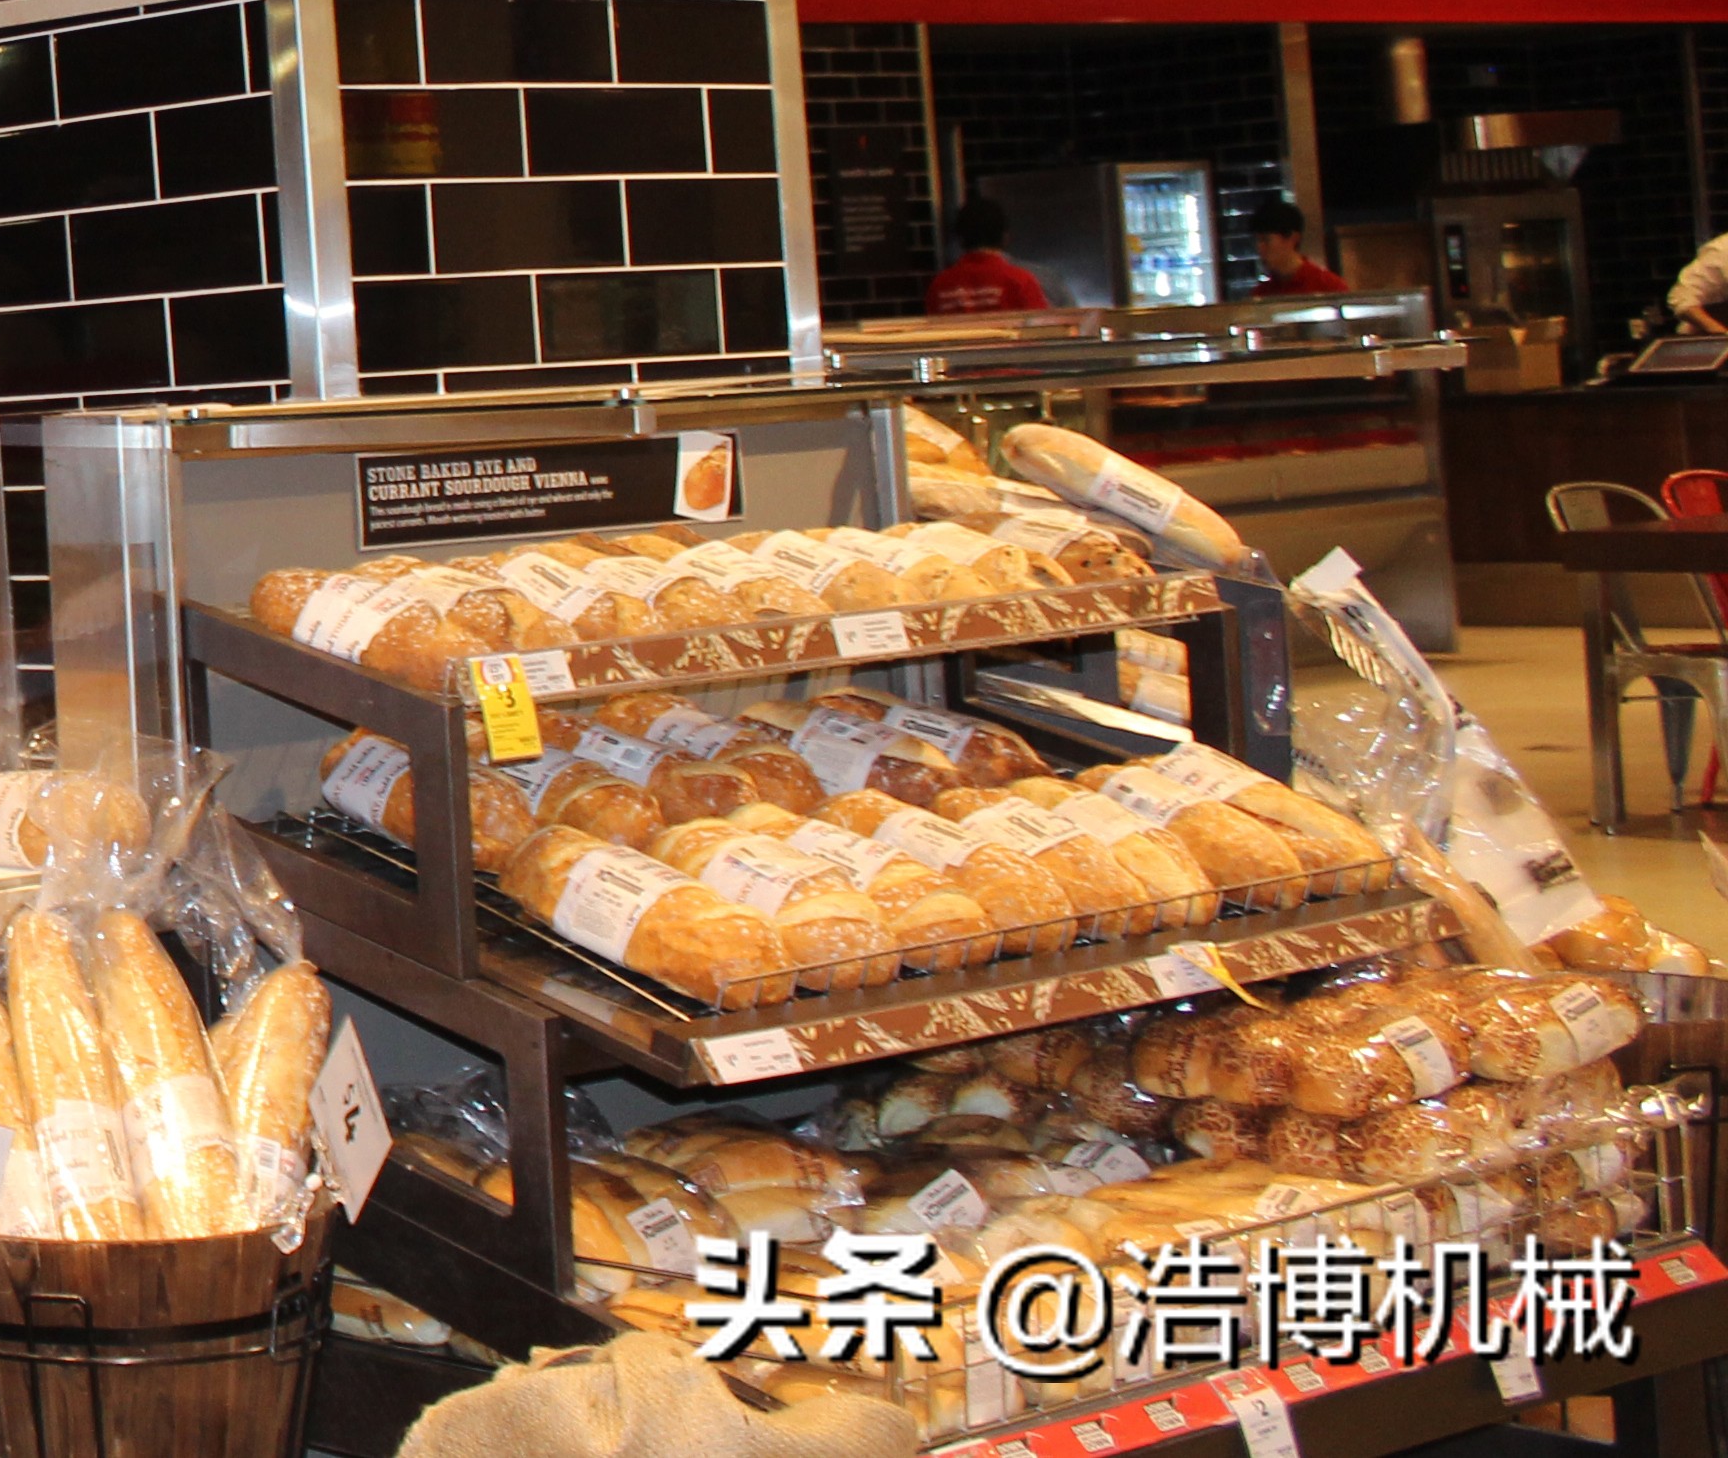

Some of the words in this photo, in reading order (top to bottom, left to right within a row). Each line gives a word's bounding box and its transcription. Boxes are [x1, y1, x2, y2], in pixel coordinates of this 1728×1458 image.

[367, 465, 416, 483] STONE
[420, 461, 471, 479] BAKED
[475, 459, 504, 476] RYE
[506, 457, 537, 473] AND
[368, 482, 441, 501] CURRANT
[444, 475, 531, 496] SOURDOUGH
[534, 471, 588, 489] VIENNA
